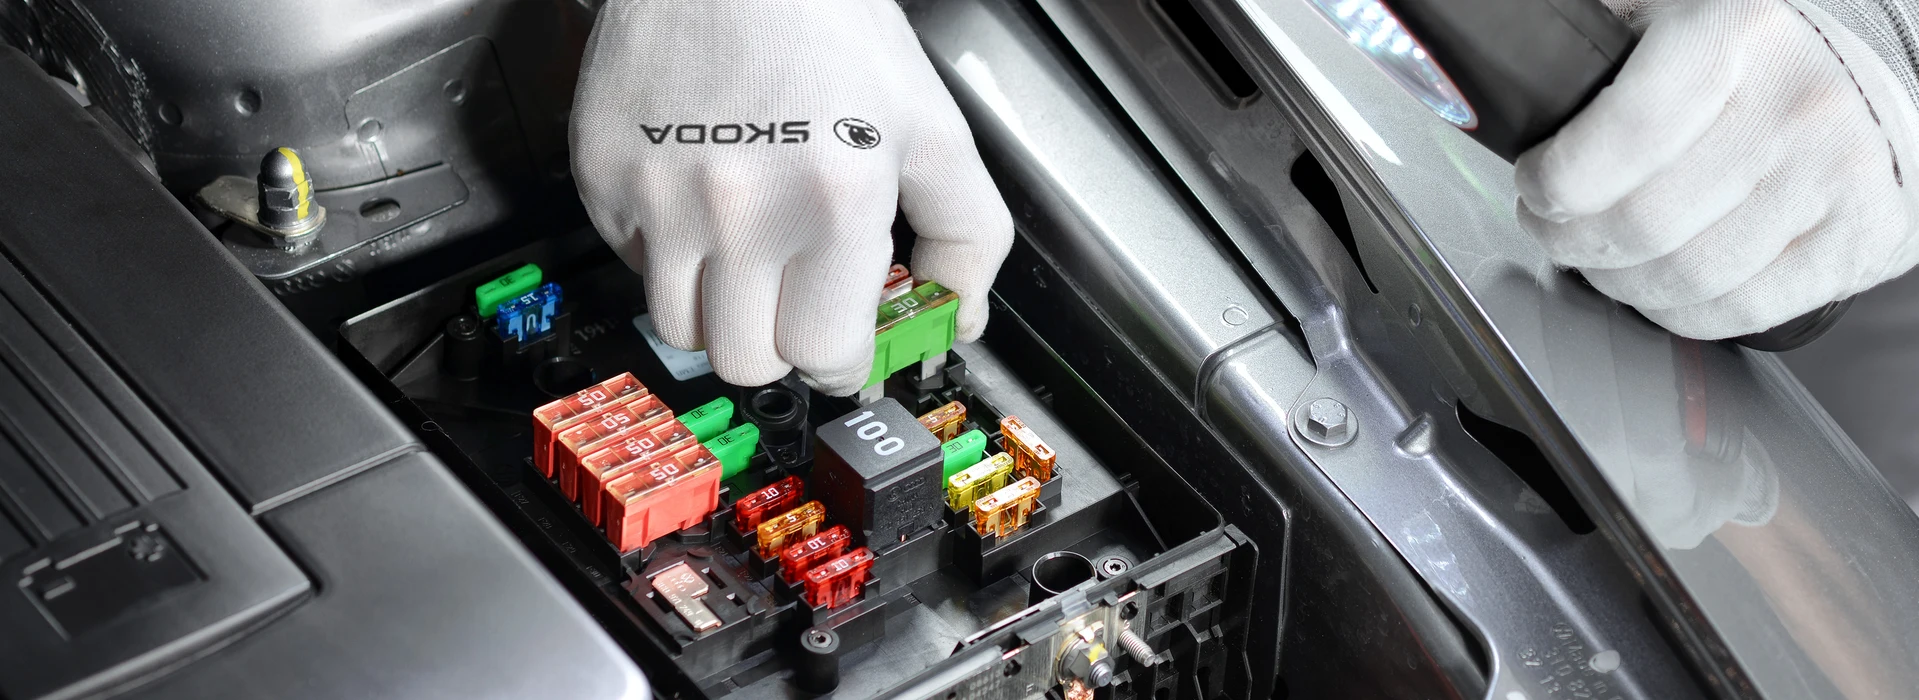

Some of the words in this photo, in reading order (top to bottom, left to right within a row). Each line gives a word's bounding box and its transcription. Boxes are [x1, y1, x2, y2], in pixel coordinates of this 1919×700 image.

[498, 275, 515, 288] 30
[520, 292, 539, 305] 15
[890, 297, 918, 314] 30
[577, 389, 607, 406] 50
[601, 412, 631, 430] 50
[690, 408, 708, 421] 30
[843, 410, 905, 456] 100
[625, 437, 655, 455] 50
[717, 434, 735, 447] 30
[946, 441, 964, 454] 30
[650, 462, 680, 481] 50
[761, 487, 780, 500] 10
[786, 513, 797, 523] 5
[807, 536, 826, 550] 10
[831, 558, 849, 572] 10
